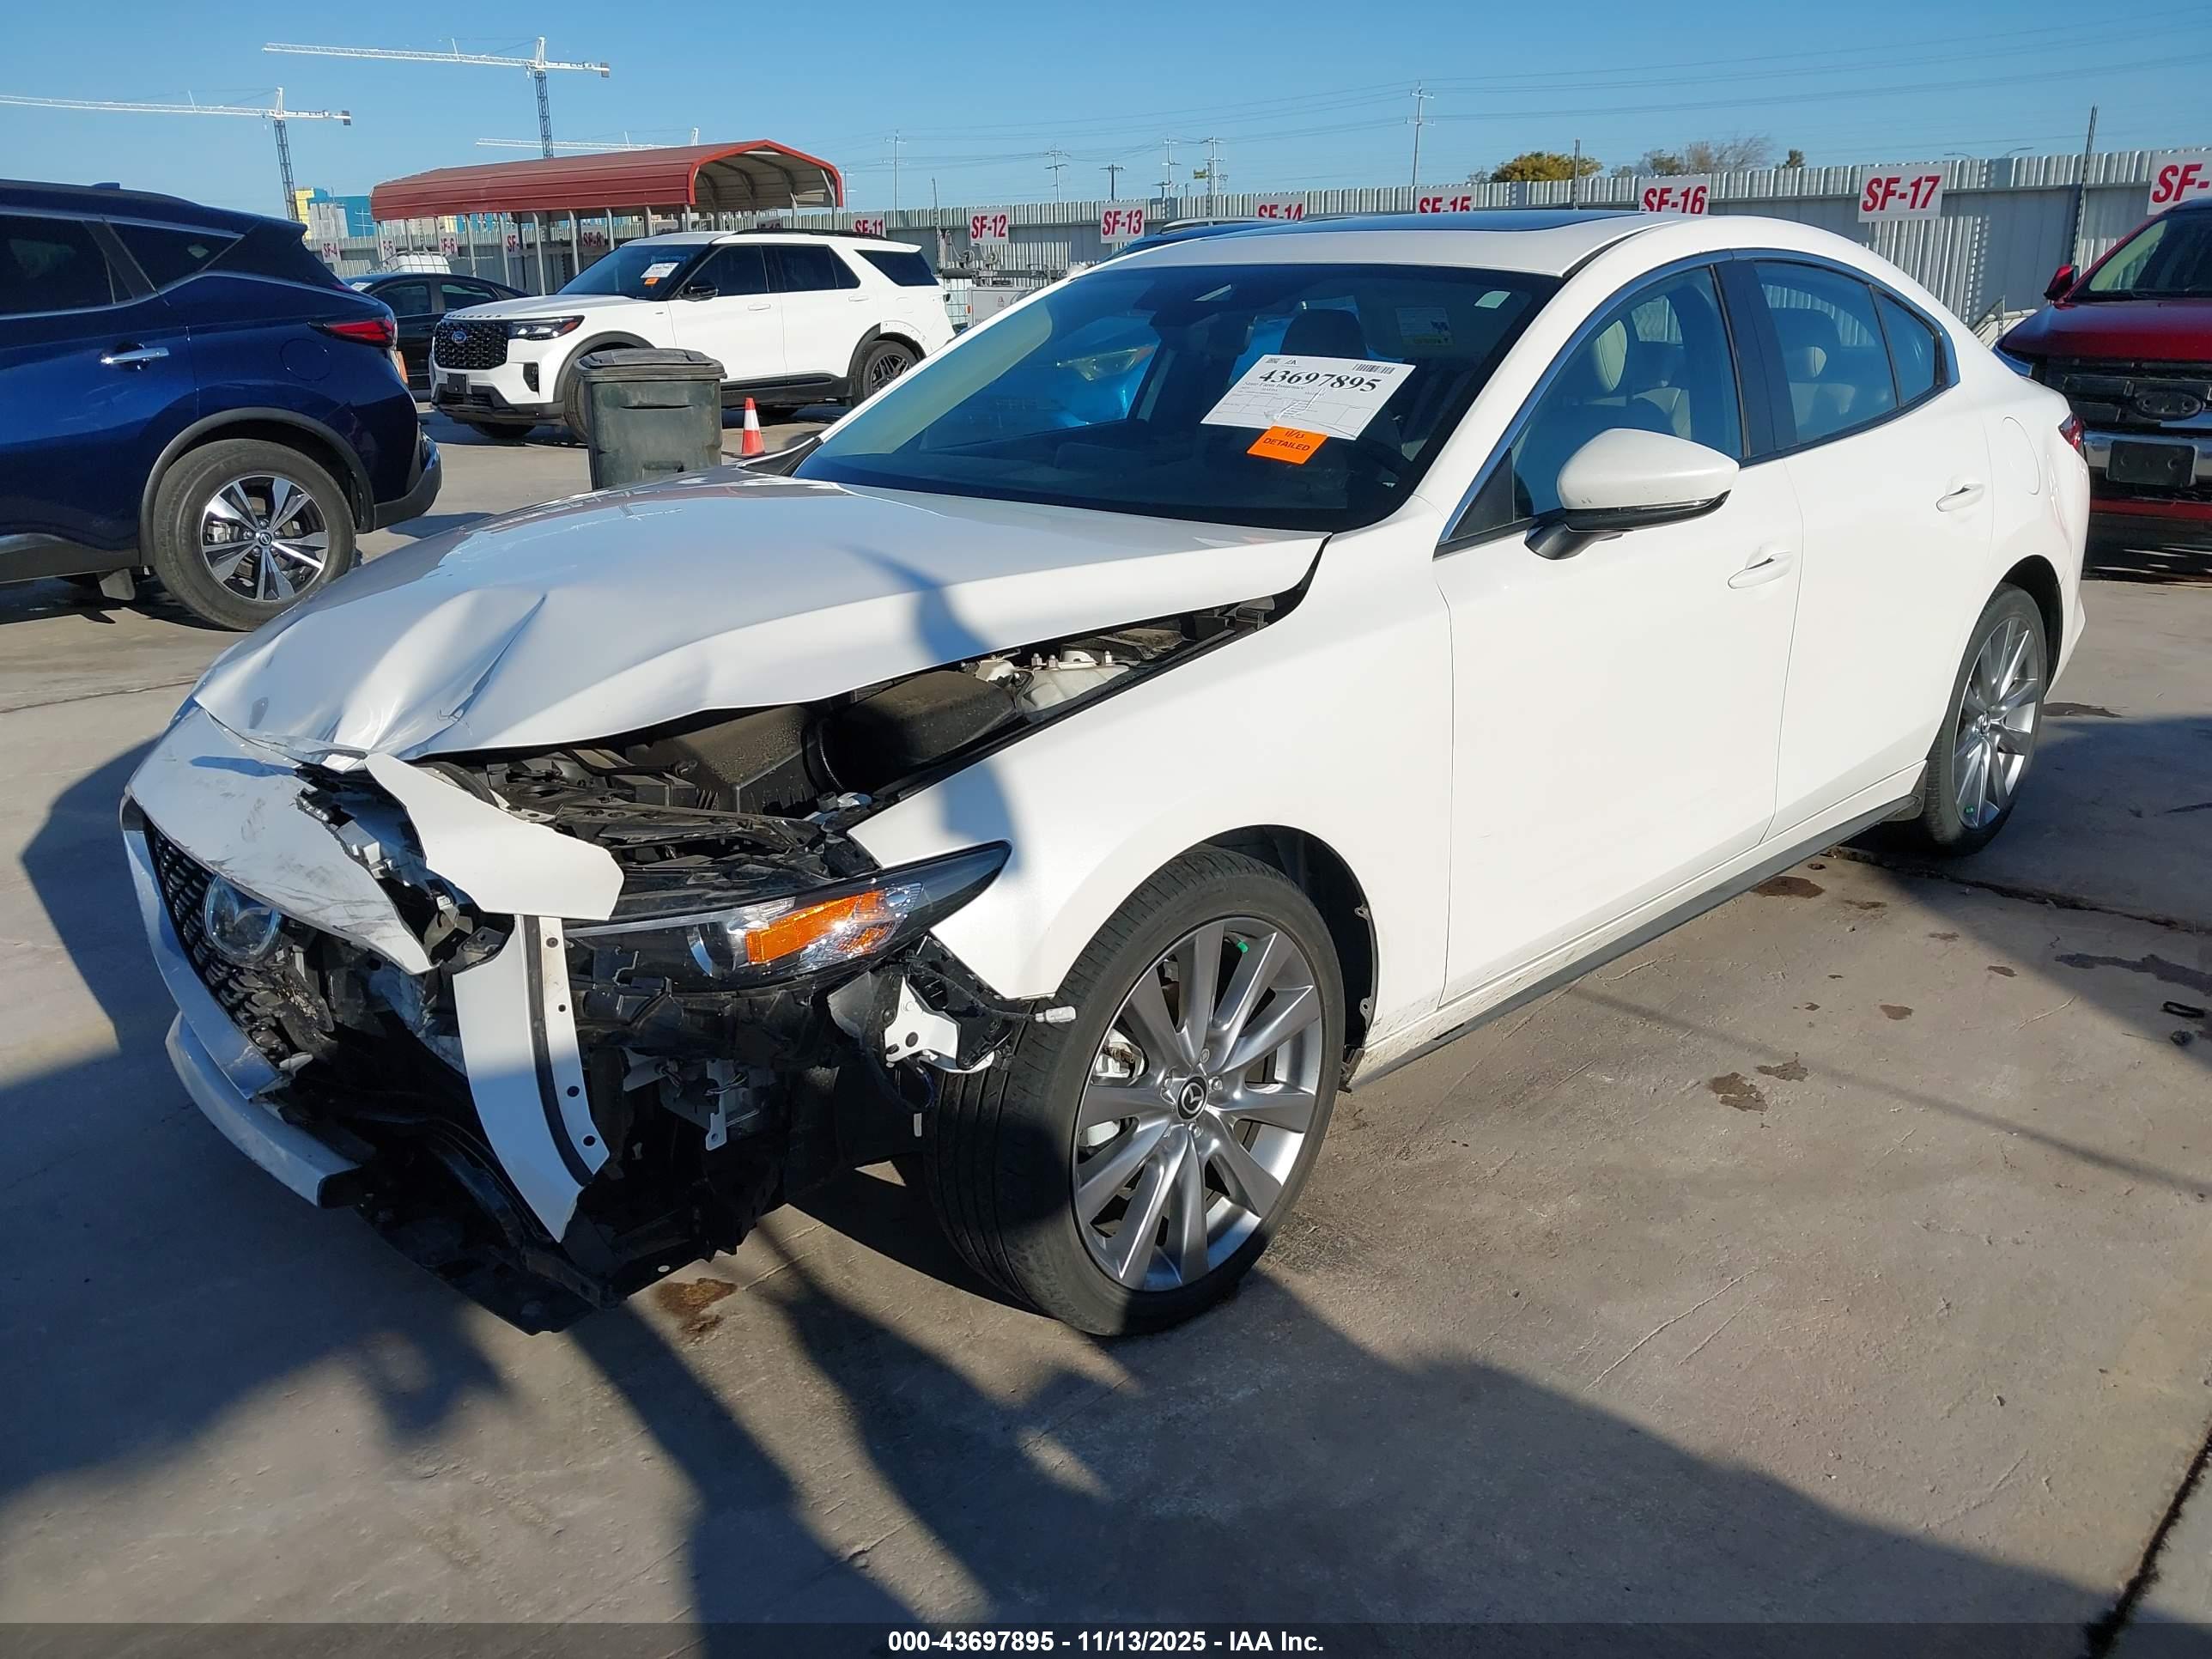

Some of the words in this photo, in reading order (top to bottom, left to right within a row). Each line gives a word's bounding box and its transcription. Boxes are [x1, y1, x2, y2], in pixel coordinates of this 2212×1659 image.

[1862, 174, 1942, 213] SF-17
[2152, 163, 2210, 204] SF-
[1643, 185, 1707, 215] SF-16
[854, 218, 884, 234] SF-11
[970, 214, 1007, 240] SF-12
[1102, 209, 1143, 236] SF-13
[383, 240, 394, 256] F-5
[507, 234, 520, 252] SF-
[1259, 369, 1382, 392] 43697895
[1262, 437, 1310, 451] DETAILED
